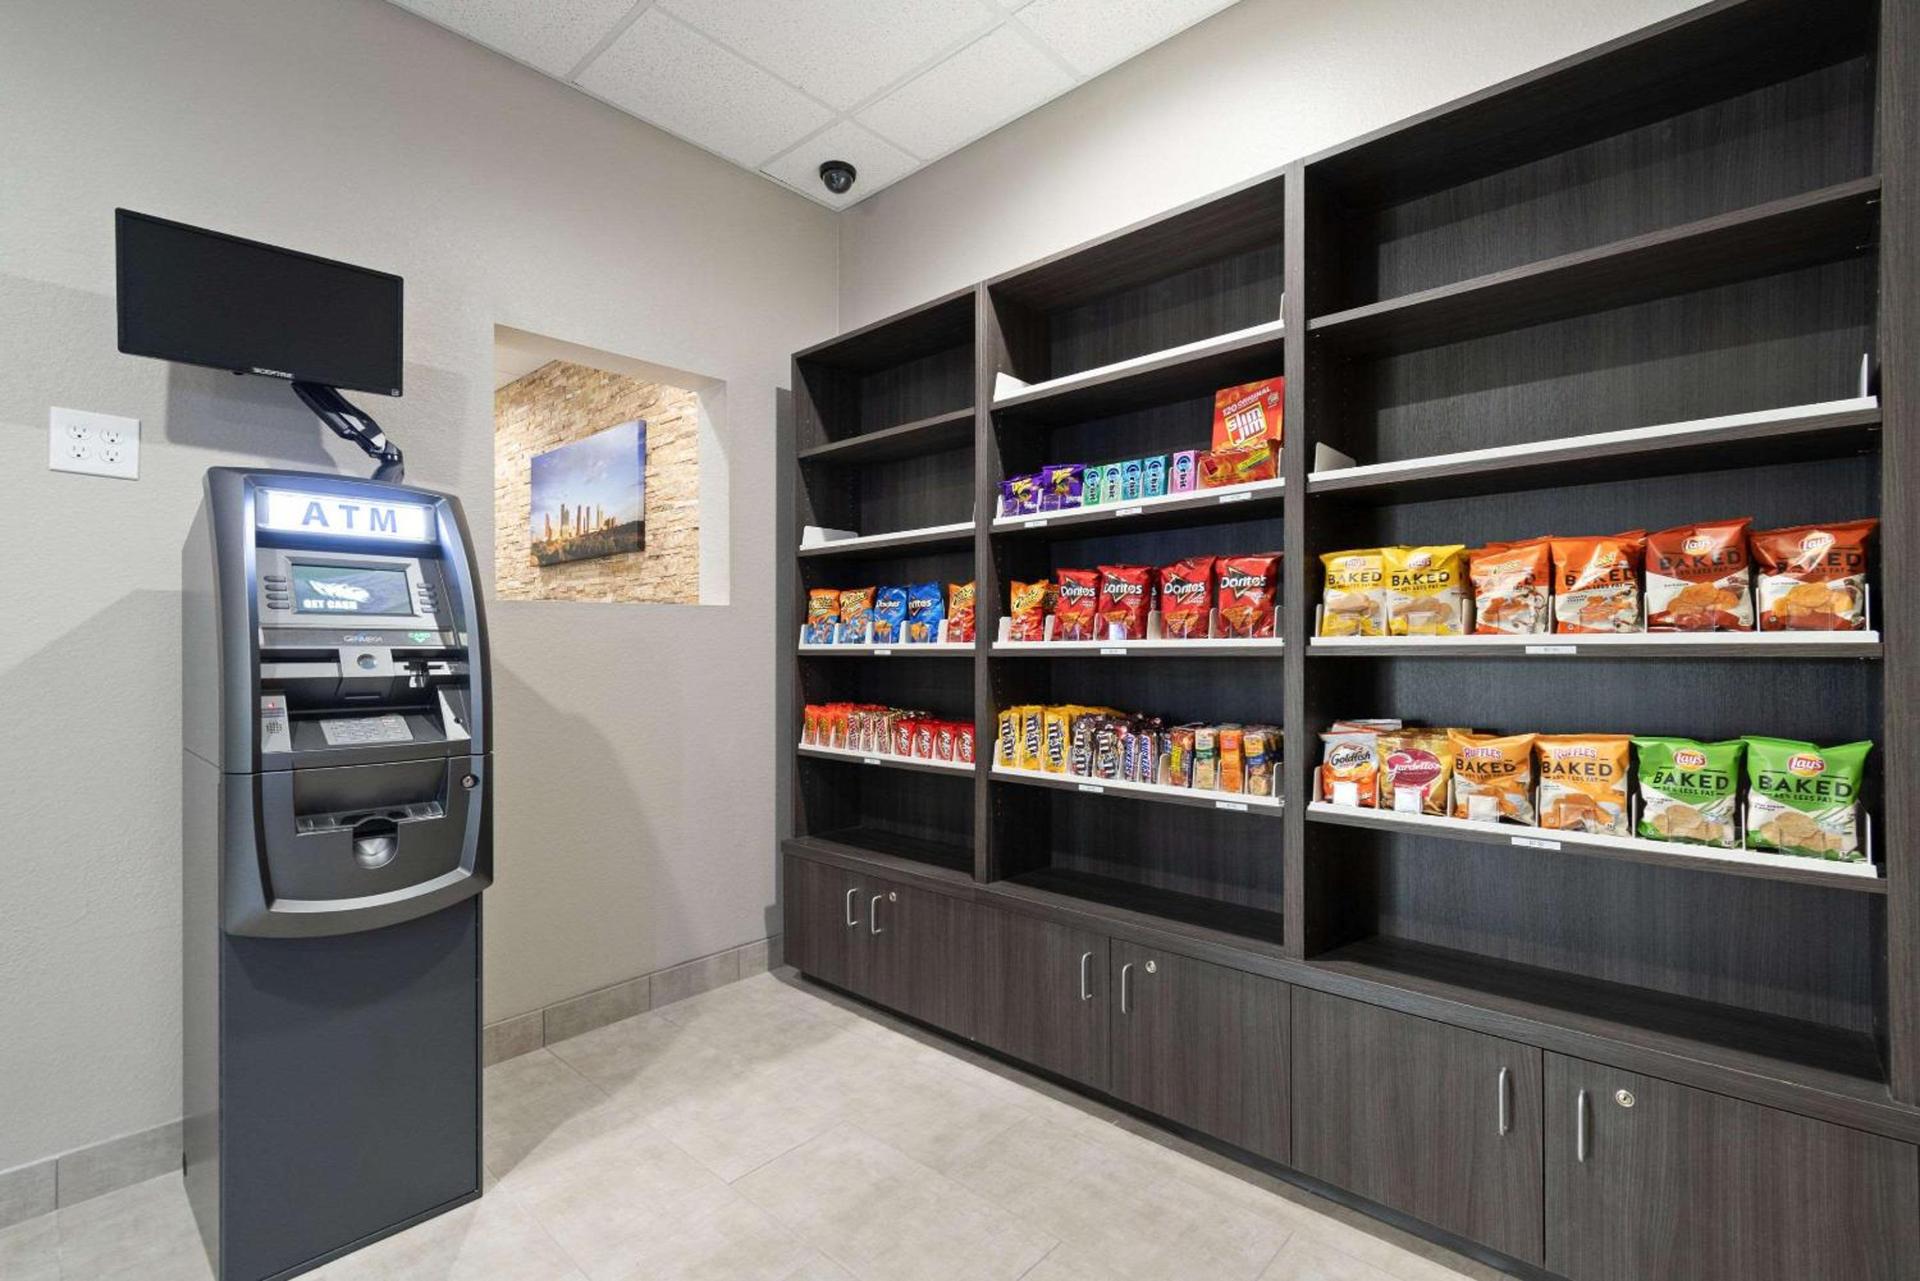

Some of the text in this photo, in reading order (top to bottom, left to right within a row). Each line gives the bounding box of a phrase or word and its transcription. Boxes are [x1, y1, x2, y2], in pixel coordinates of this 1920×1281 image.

[302, 502, 397, 533] ATM
[1221, 575, 1266, 588] Doritos
[1392, 571, 1450, 586] BAKED
[1061, 586, 1095, 597] Doritos
[1164, 582, 1205, 593] Doritos
[1331, 750, 1371, 766] Goldfish
[1464, 747, 1501, 758] RUFFLES
[1555, 749, 1597, 760] RUFFLES
[1456, 759, 1516, 774] BAKED
[1543, 761, 1612, 777] BAKED
[1654, 771, 1729, 790] BAKED
[1759, 775, 1853, 797] BAKED
